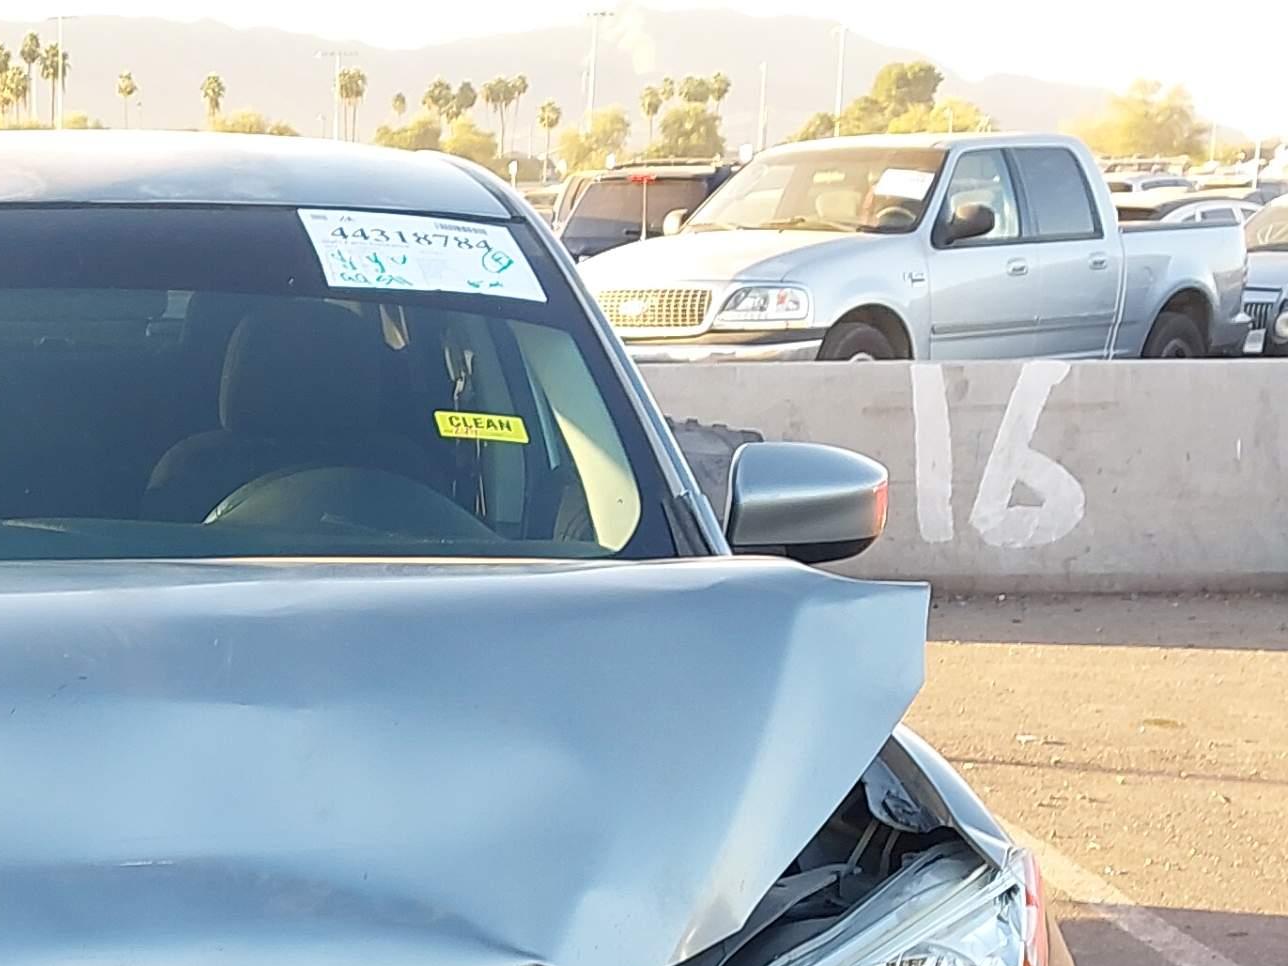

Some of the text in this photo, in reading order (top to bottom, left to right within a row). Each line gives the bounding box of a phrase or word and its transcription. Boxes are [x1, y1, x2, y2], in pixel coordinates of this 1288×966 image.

[330, 226, 492, 253] 44318784
[447, 414, 513, 432] CLEAN
[910, 361, 1086, 548] 16
